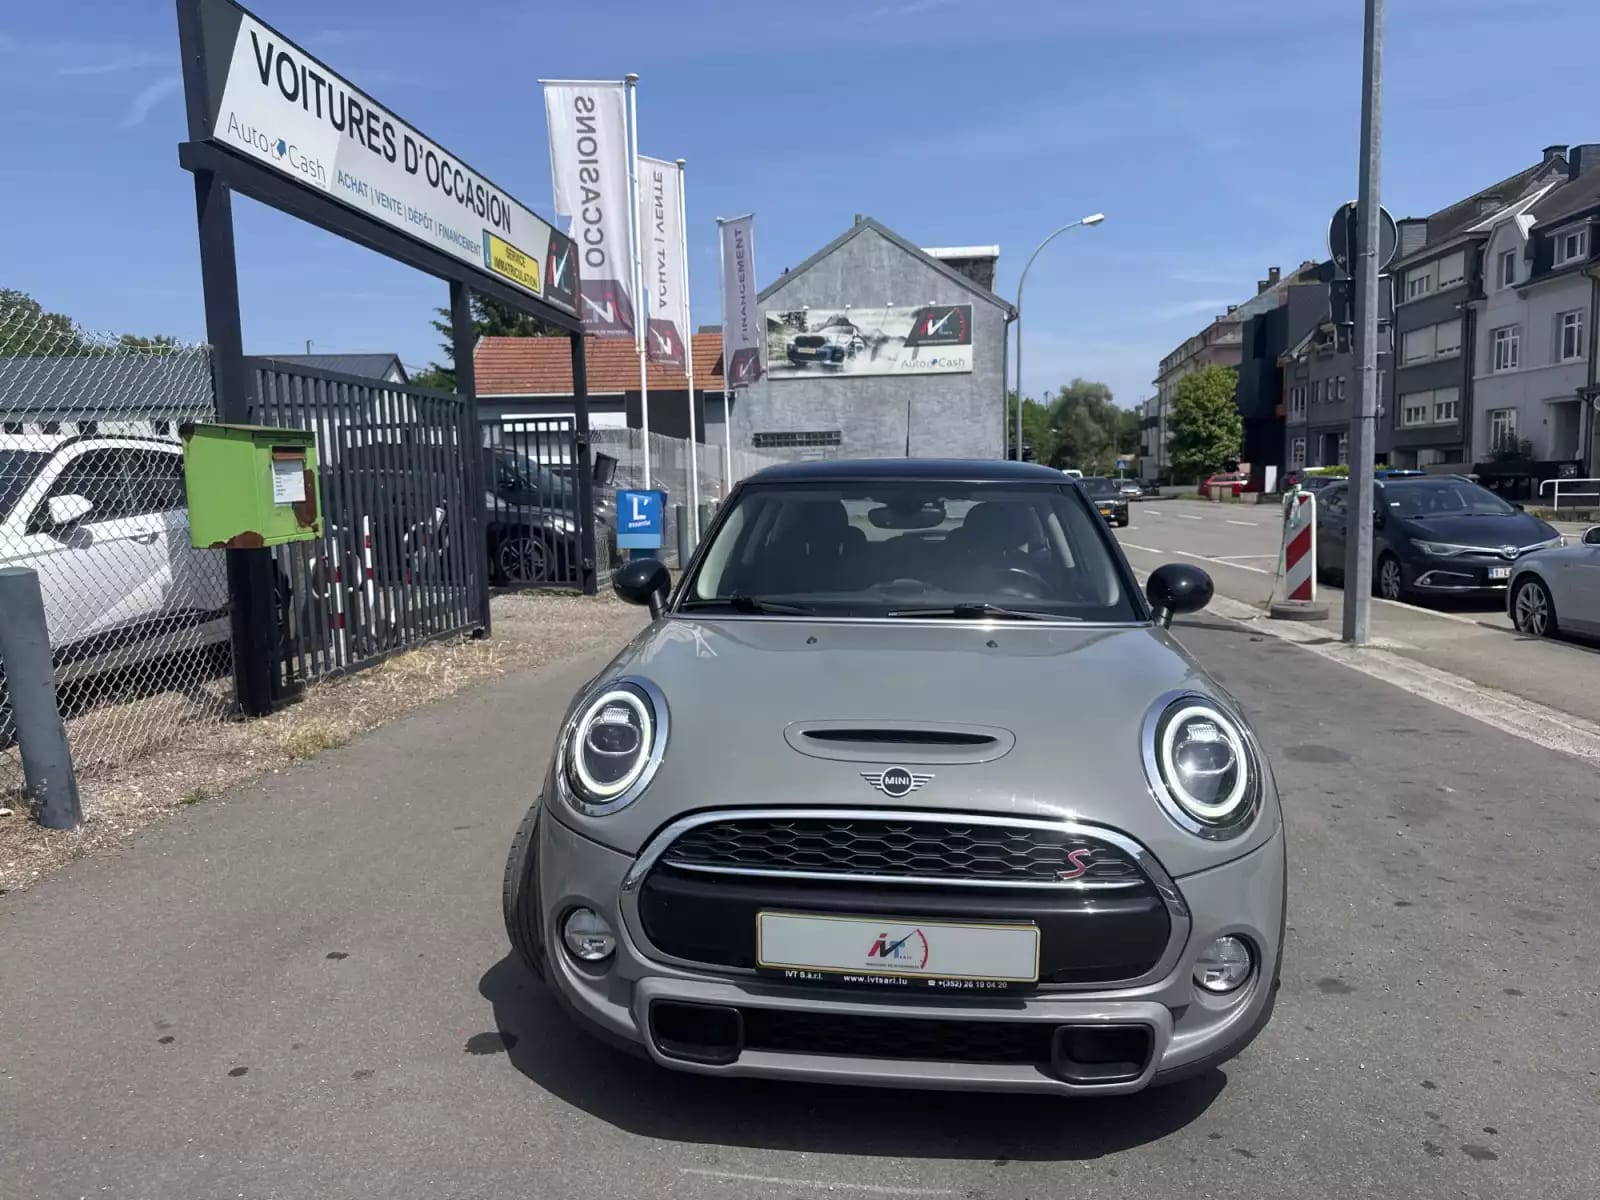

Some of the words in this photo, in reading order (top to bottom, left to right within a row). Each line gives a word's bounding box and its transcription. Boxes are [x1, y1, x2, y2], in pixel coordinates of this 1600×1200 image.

[227, 111, 269, 152] Auto
[288, 144, 327, 183] Cash
[250, 29, 396, 163] VOITURES
[403, 132, 511, 234] D'OCCASION
[337, 169, 369, 198] ACHAT
[372, 189, 403, 217] VENTE
[438, 223, 481, 257] FINANCEMENT
[734, 228, 750, 342] FINANCEMENT
[901, 359, 926, 369] Auto
[939, 357, 965, 369] Cash
[885, 776, 909, 785] MINI
[1056, 848, 1091, 880] S
[785, 970, 798, 978] IVT
[843, 975, 908, 985] www.ivtsarl.lu
